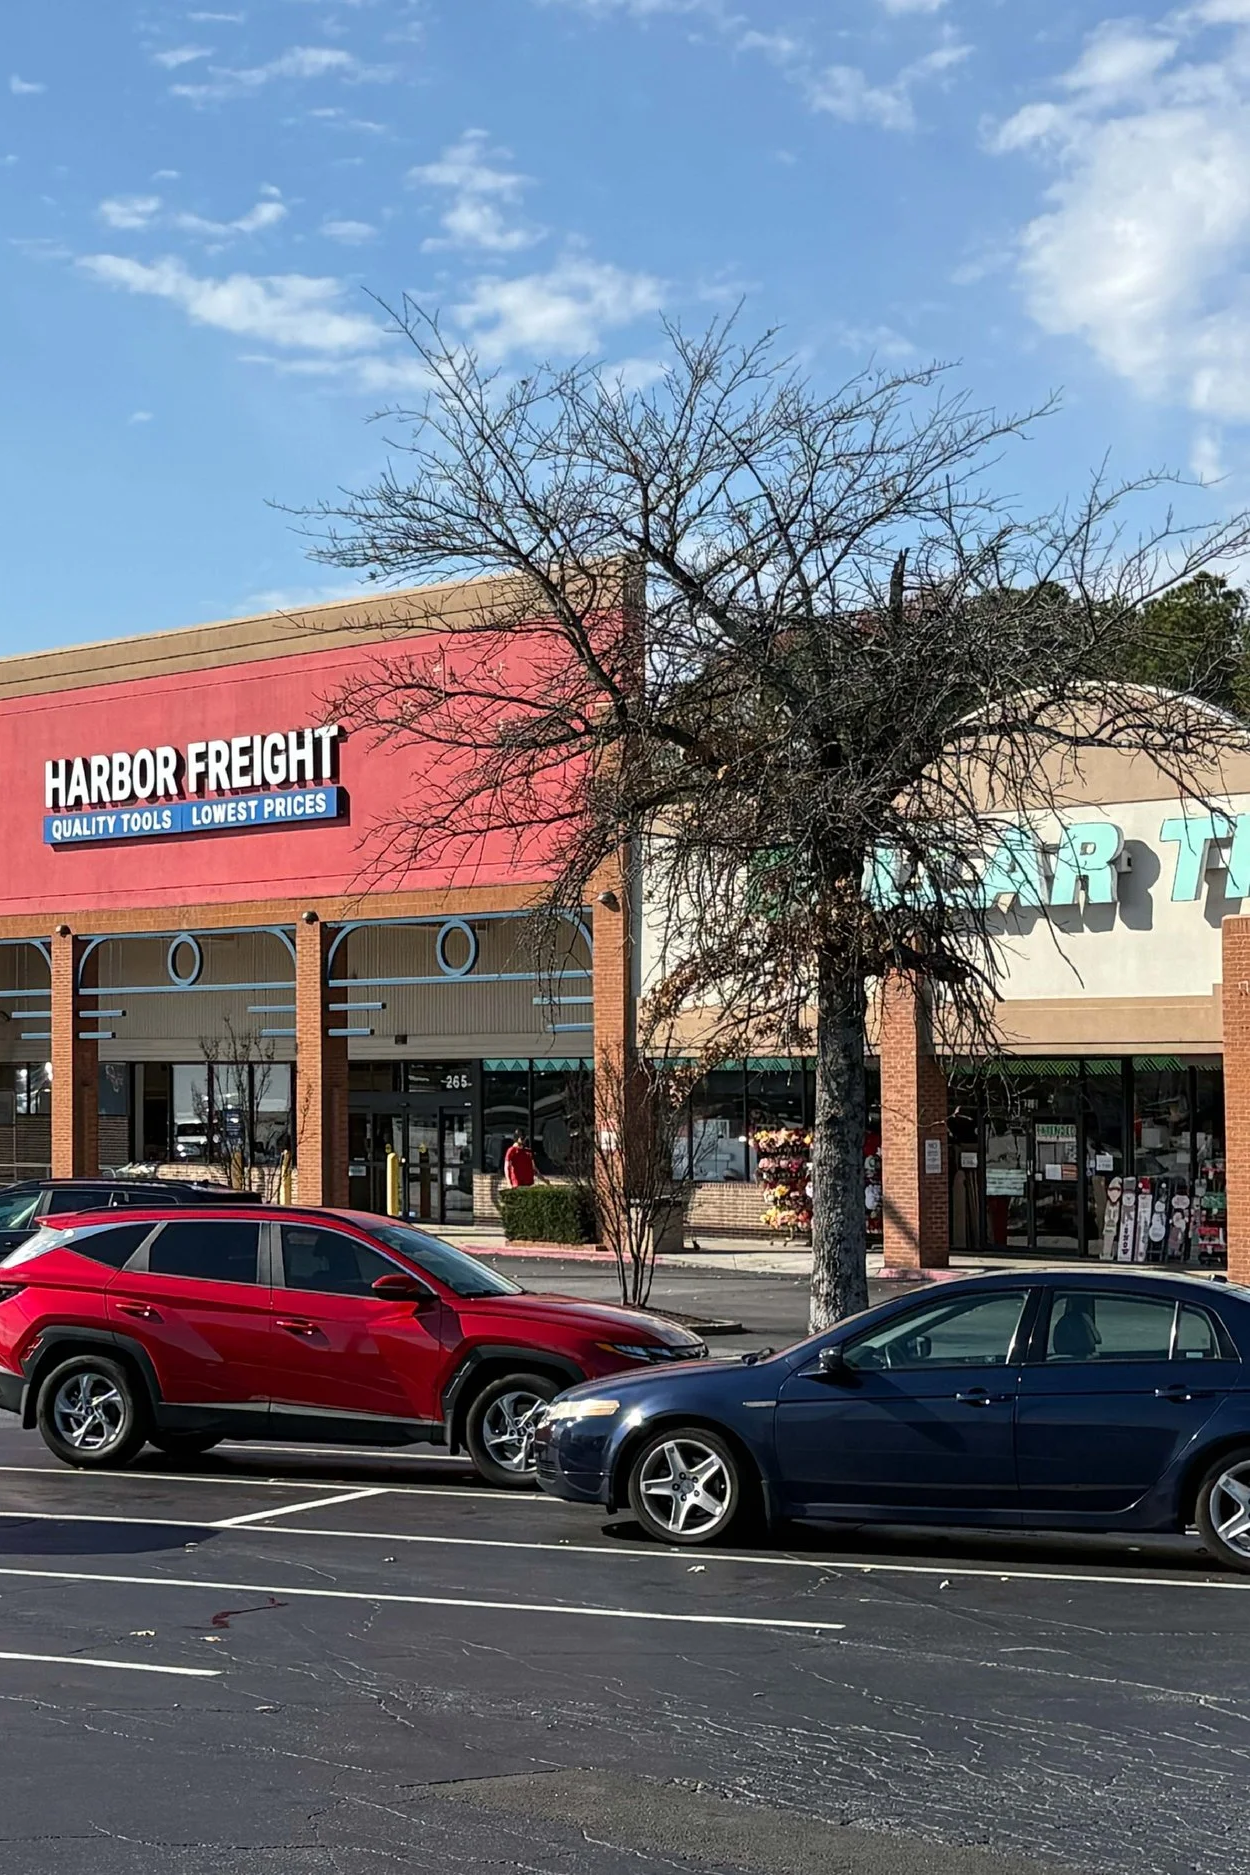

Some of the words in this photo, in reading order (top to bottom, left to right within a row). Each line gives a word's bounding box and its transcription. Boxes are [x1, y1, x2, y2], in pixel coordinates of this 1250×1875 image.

[45, 746, 178, 808] HARBOR
[187, 725, 339, 793] FREIGHT
[52, 814, 116, 839] QUALITY
[121, 810, 172, 834] TOOLS
[192, 800, 258, 827] LOWEST
[264, 793, 327, 819] PRICES
[445, 1074, 468, 1089] 265
